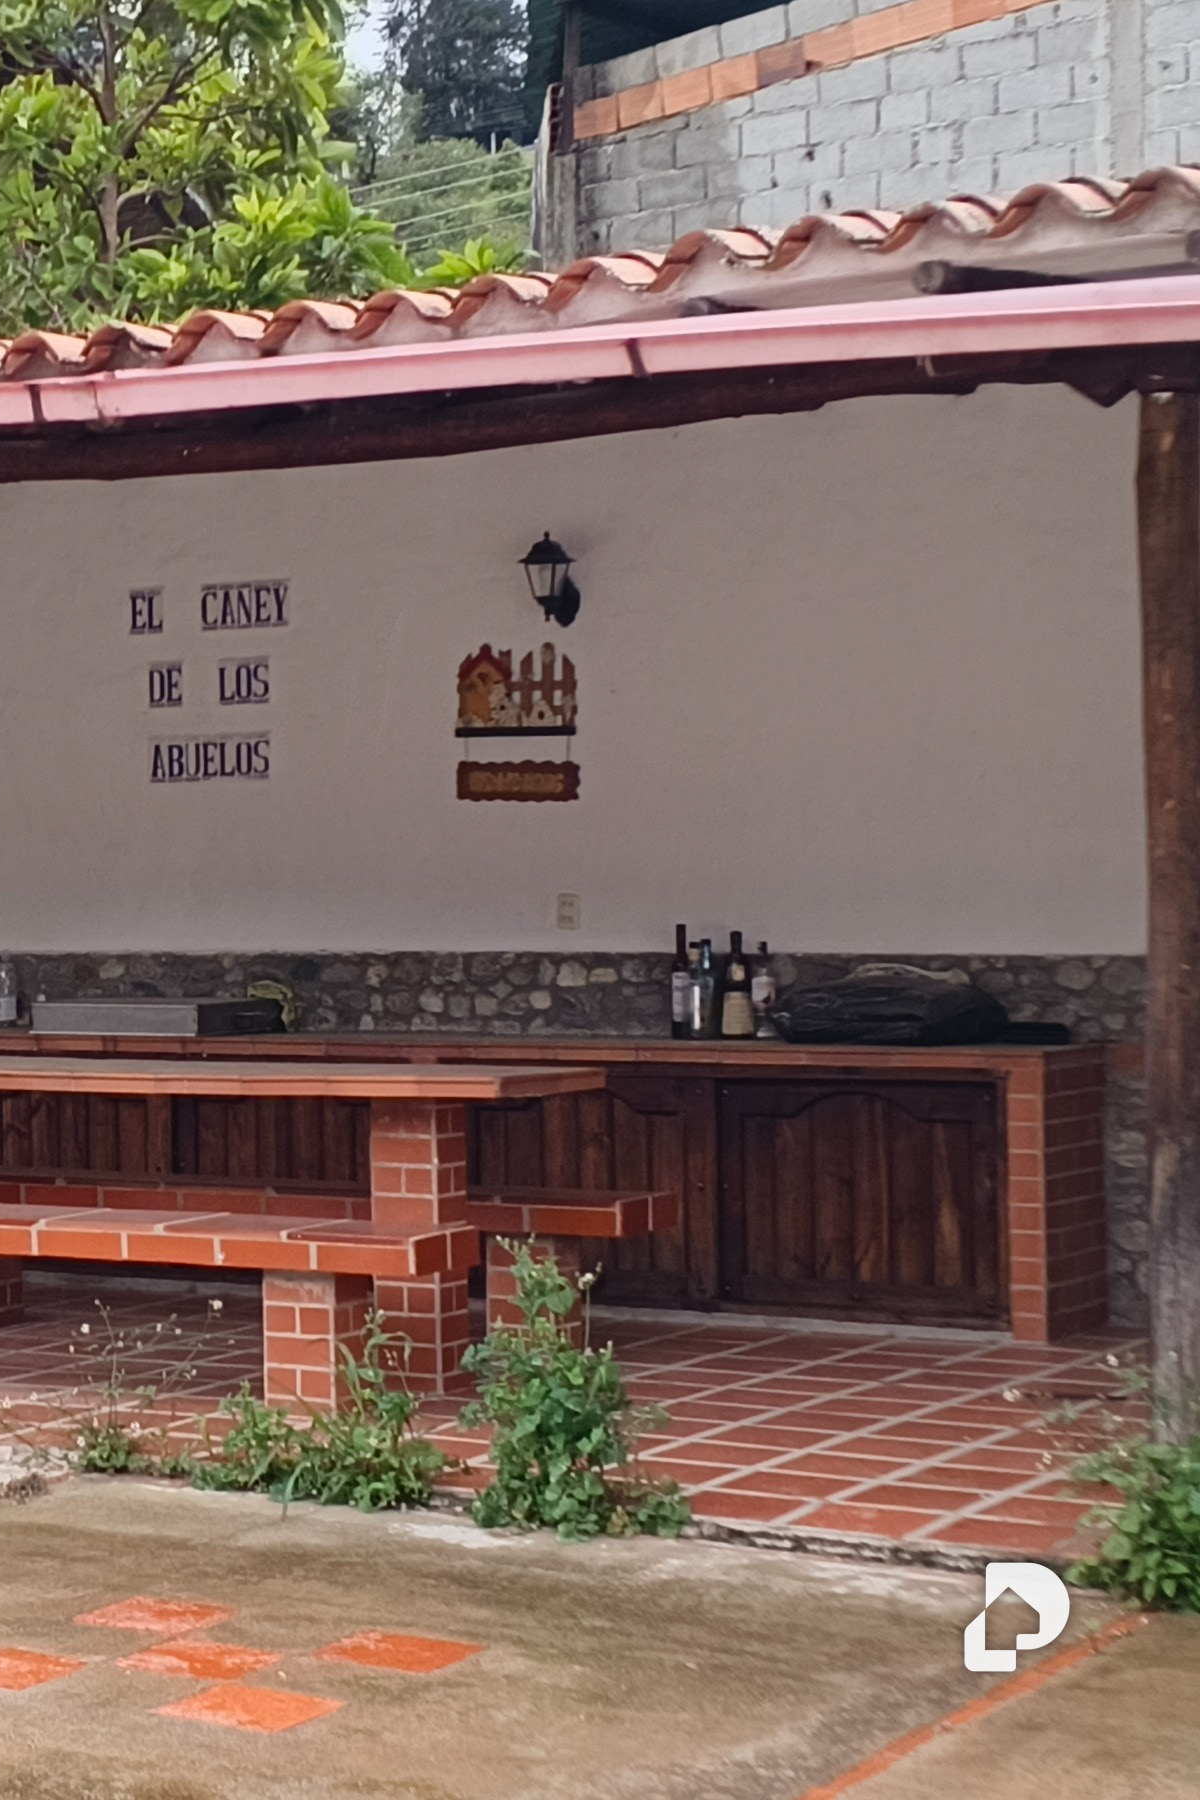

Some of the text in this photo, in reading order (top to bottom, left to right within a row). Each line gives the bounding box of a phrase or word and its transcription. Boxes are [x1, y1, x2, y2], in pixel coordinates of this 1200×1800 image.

[130, 583, 288, 631] EL CANEY
[149, 663, 269, 703] DE LOS
[150, 738, 270, 779] ABUELOS
